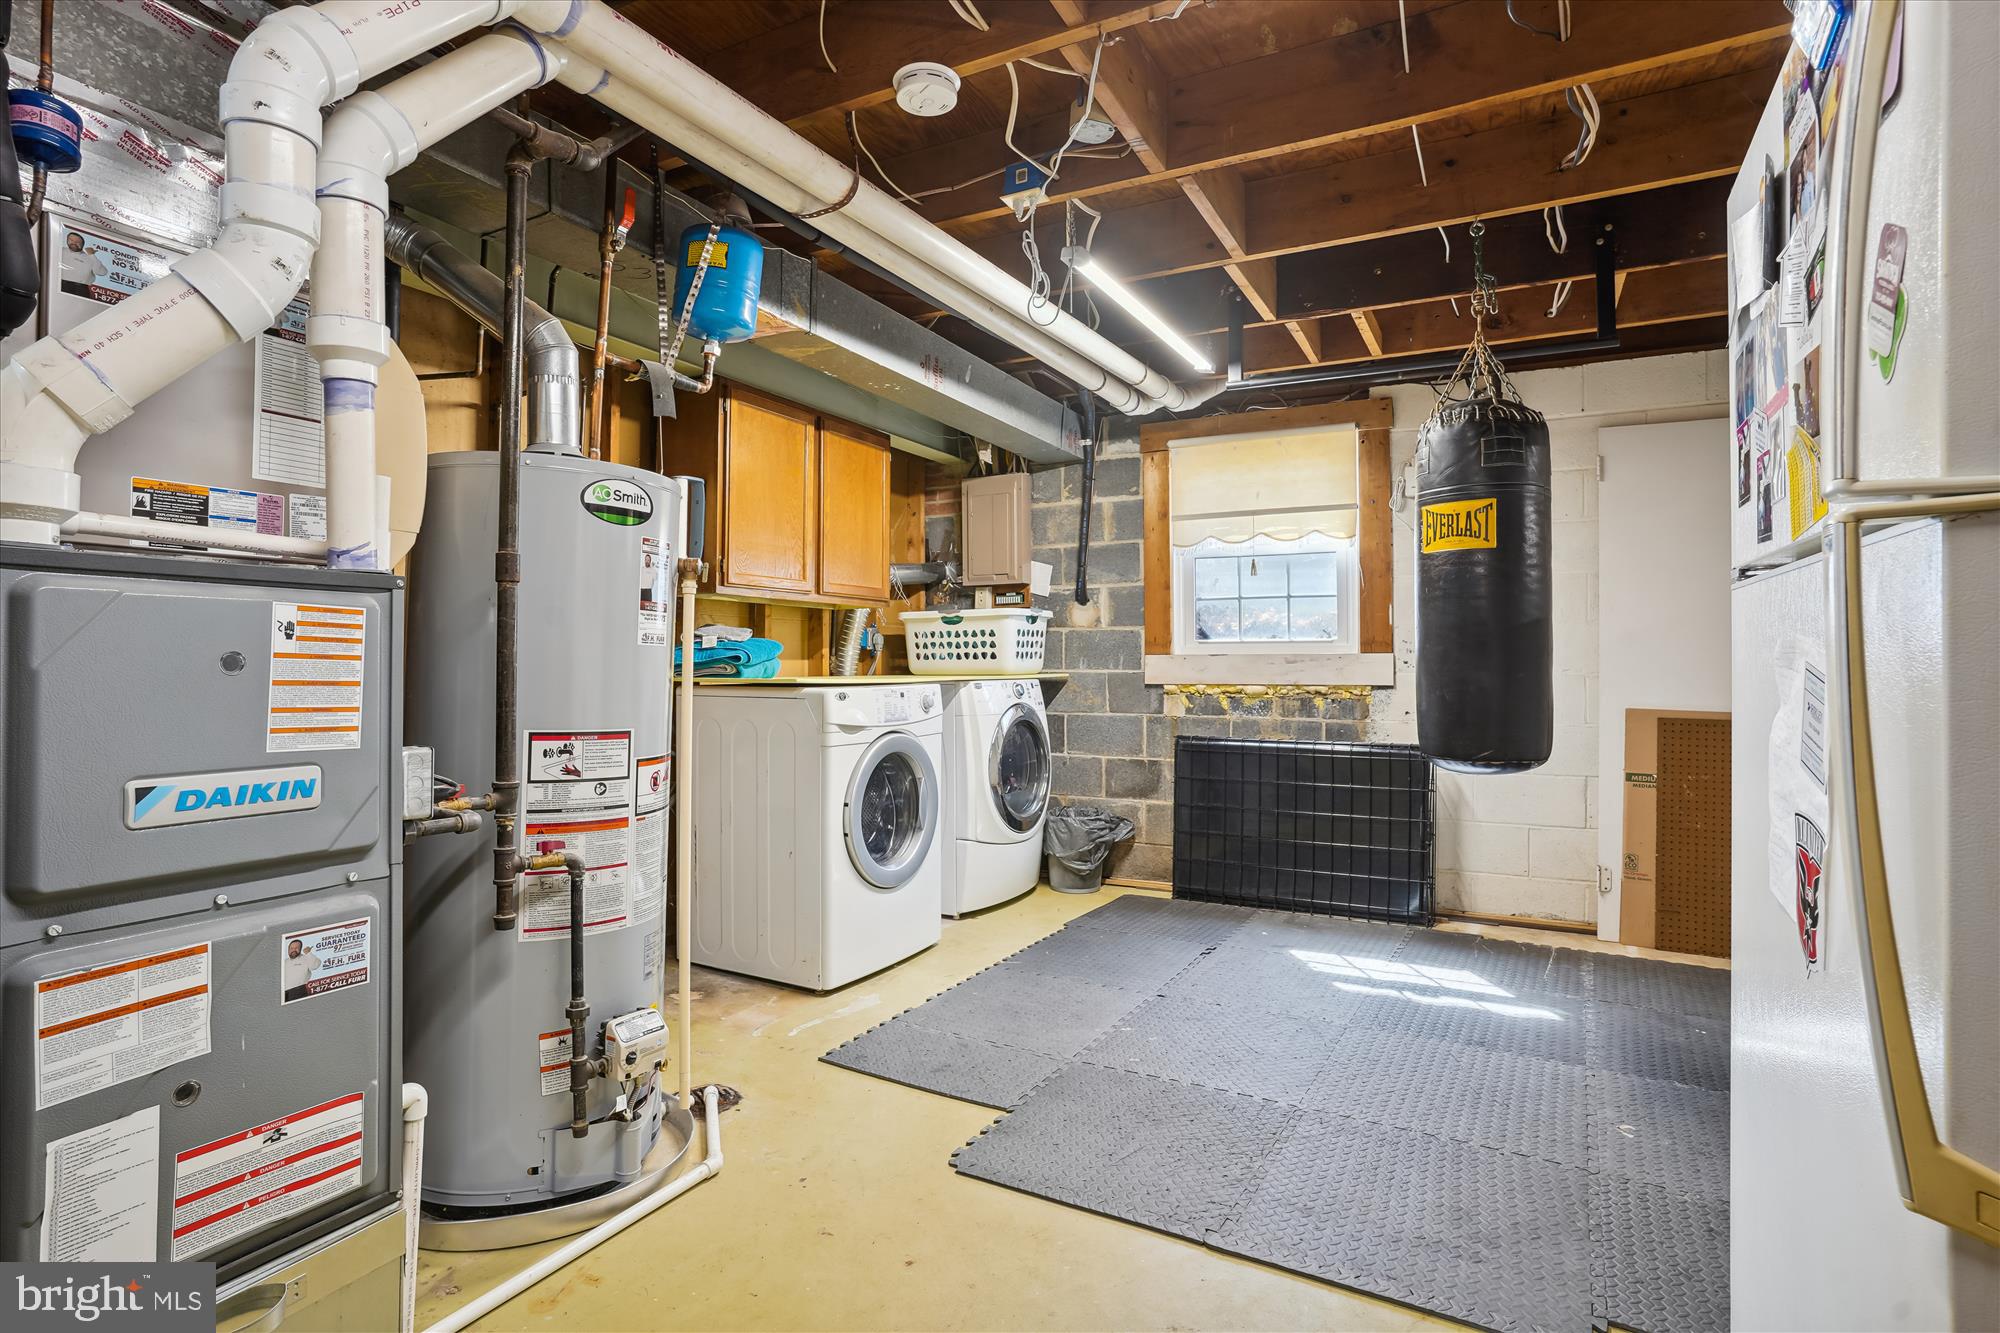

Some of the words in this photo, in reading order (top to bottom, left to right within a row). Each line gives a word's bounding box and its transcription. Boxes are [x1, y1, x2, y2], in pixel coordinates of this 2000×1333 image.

[119, 99, 140, 114] COLD
[112, 259, 127, 269] NO
[134, 313, 153, 327] TYPE
[107, 330, 123, 343] SCH
[94, 341, 105, 350] 40
[613, 489, 647, 506] Smith
[1425, 502, 1493, 548] EVERLAST
[175, 778, 317, 812] DAIKIN
[315, 933, 366, 949] GUARANTEED
[321, 932, 343, 941] SERVICE
[343, 929, 361, 937] TODAY
[333, 944, 342, 952] 97
[331, 958, 345, 966] F.H.
[348, 953, 366, 962] FURR
[330, 973, 350, 982] SERVICE
[350, 969, 367, 978] TODAY
[348, 974, 366, 984] FURR
[261, 1119, 287, 1132] DANGER
[259, 1160, 285, 1174] DANGER
[258, 1188, 285, 1202] PELIGRO
